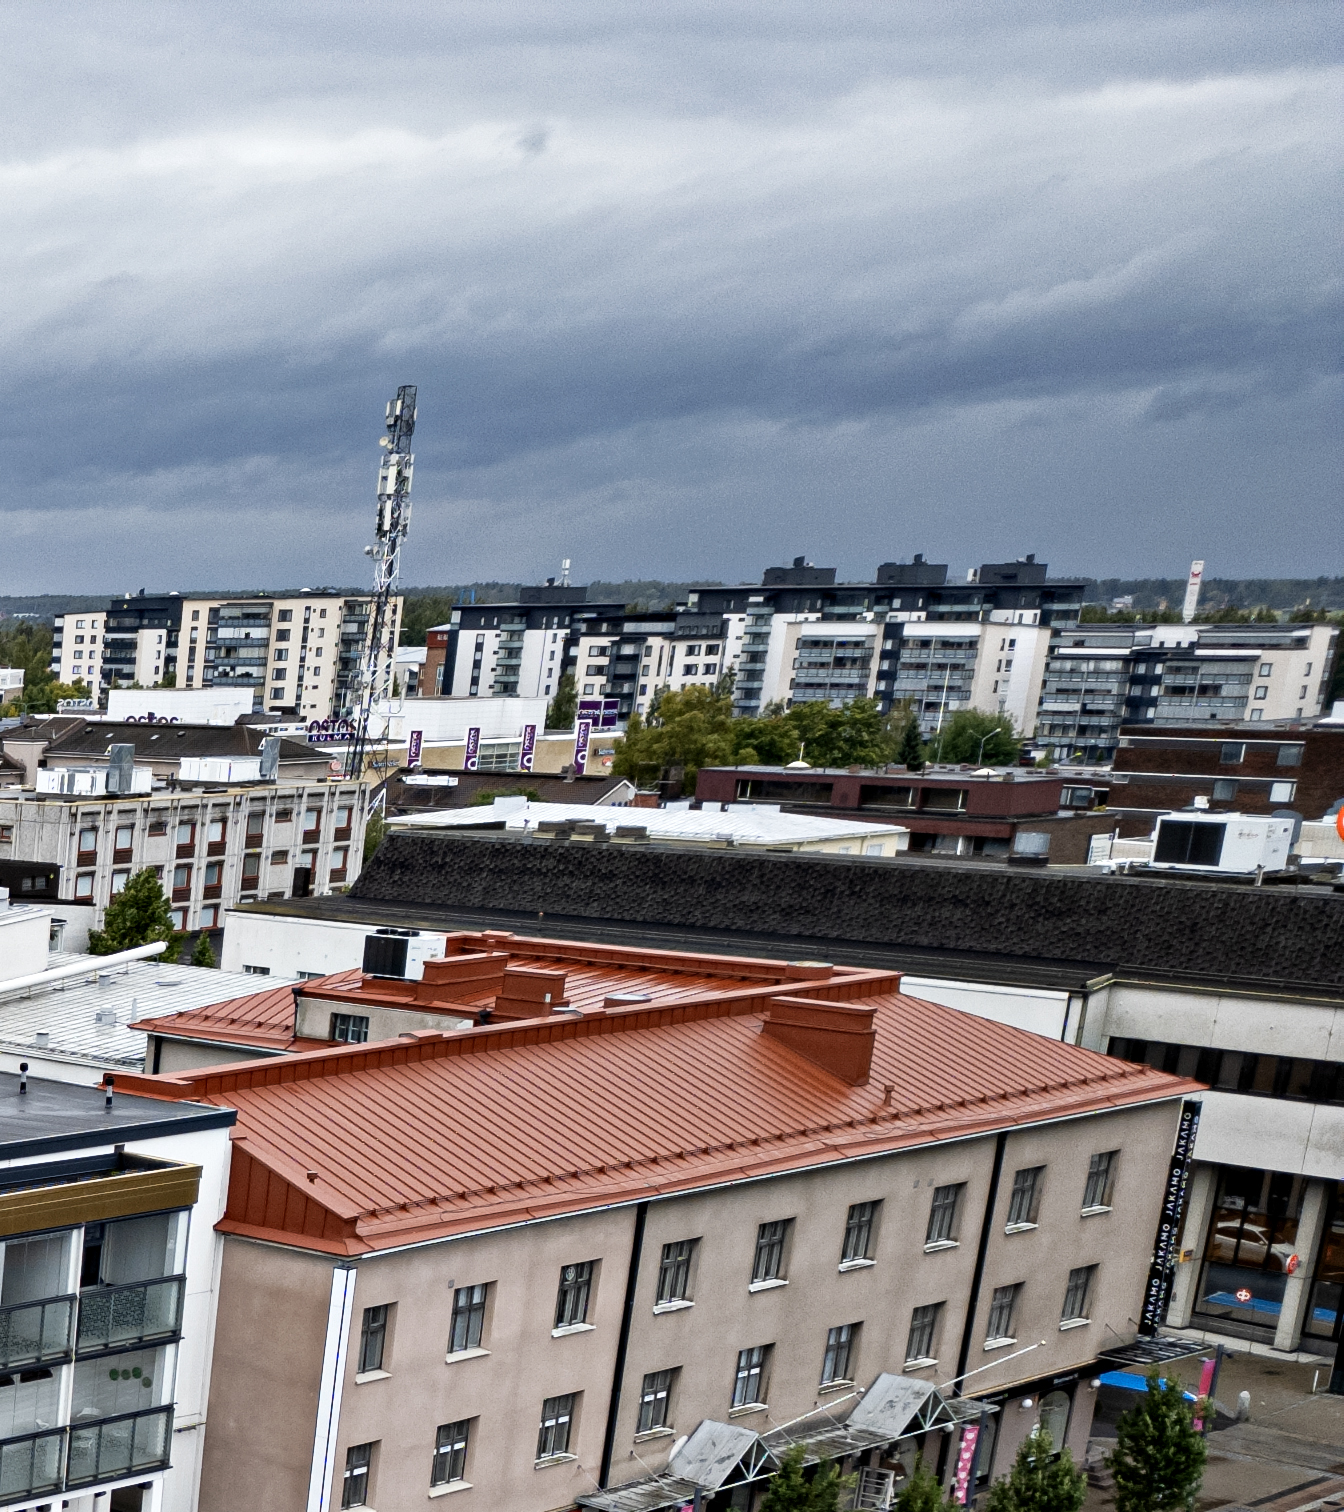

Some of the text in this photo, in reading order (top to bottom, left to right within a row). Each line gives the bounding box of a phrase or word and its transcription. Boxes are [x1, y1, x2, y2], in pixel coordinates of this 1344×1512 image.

[1175, 1112, 1192, 1160] JAKAMO
[1166, 1168, 1181, 1215] JAKAMO
[1154, 1223, 1171, 1271] JAKAMO
[1144, 1278, 1159, 1325] JAKAMO
